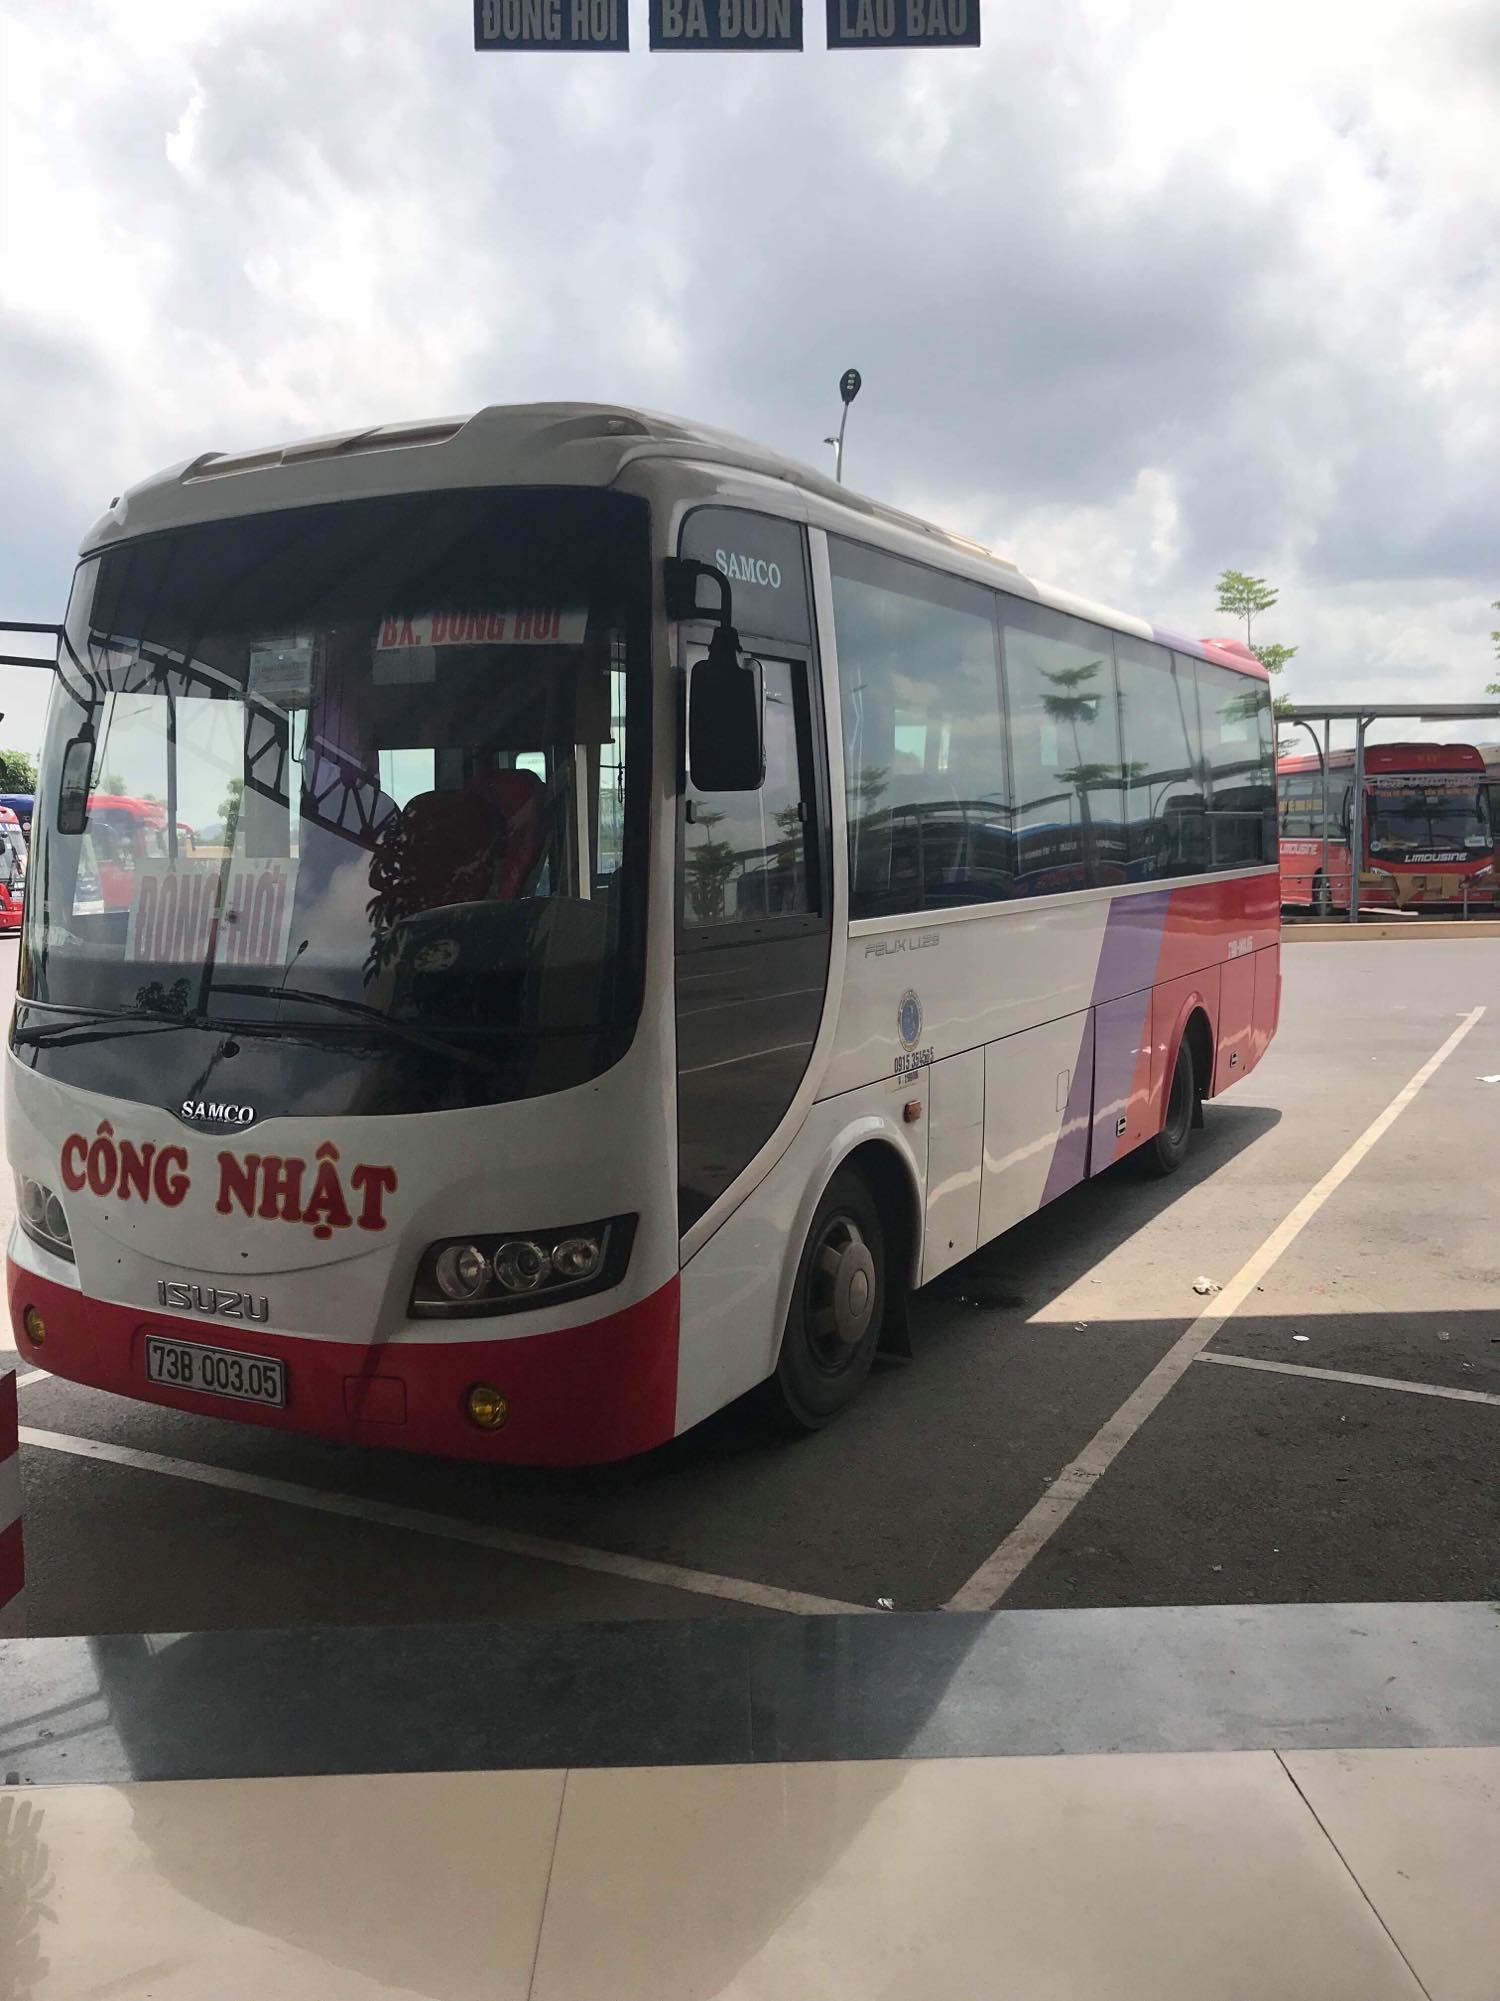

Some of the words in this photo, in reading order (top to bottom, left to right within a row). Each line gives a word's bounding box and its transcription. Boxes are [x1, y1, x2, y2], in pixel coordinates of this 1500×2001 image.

[716, 549, 781, 588] SAMCO
[181, 1100, 254, 1124] SAMCO
[61, 1120, 191, 1207] CÔNG
[215, 1141, 398, 1239] NHẬT
[157, 1280, 269, 1322] ISUZU
[152, 1345, 194, 1381] 73B
[202, 1354, 277, 1399] 003.05
